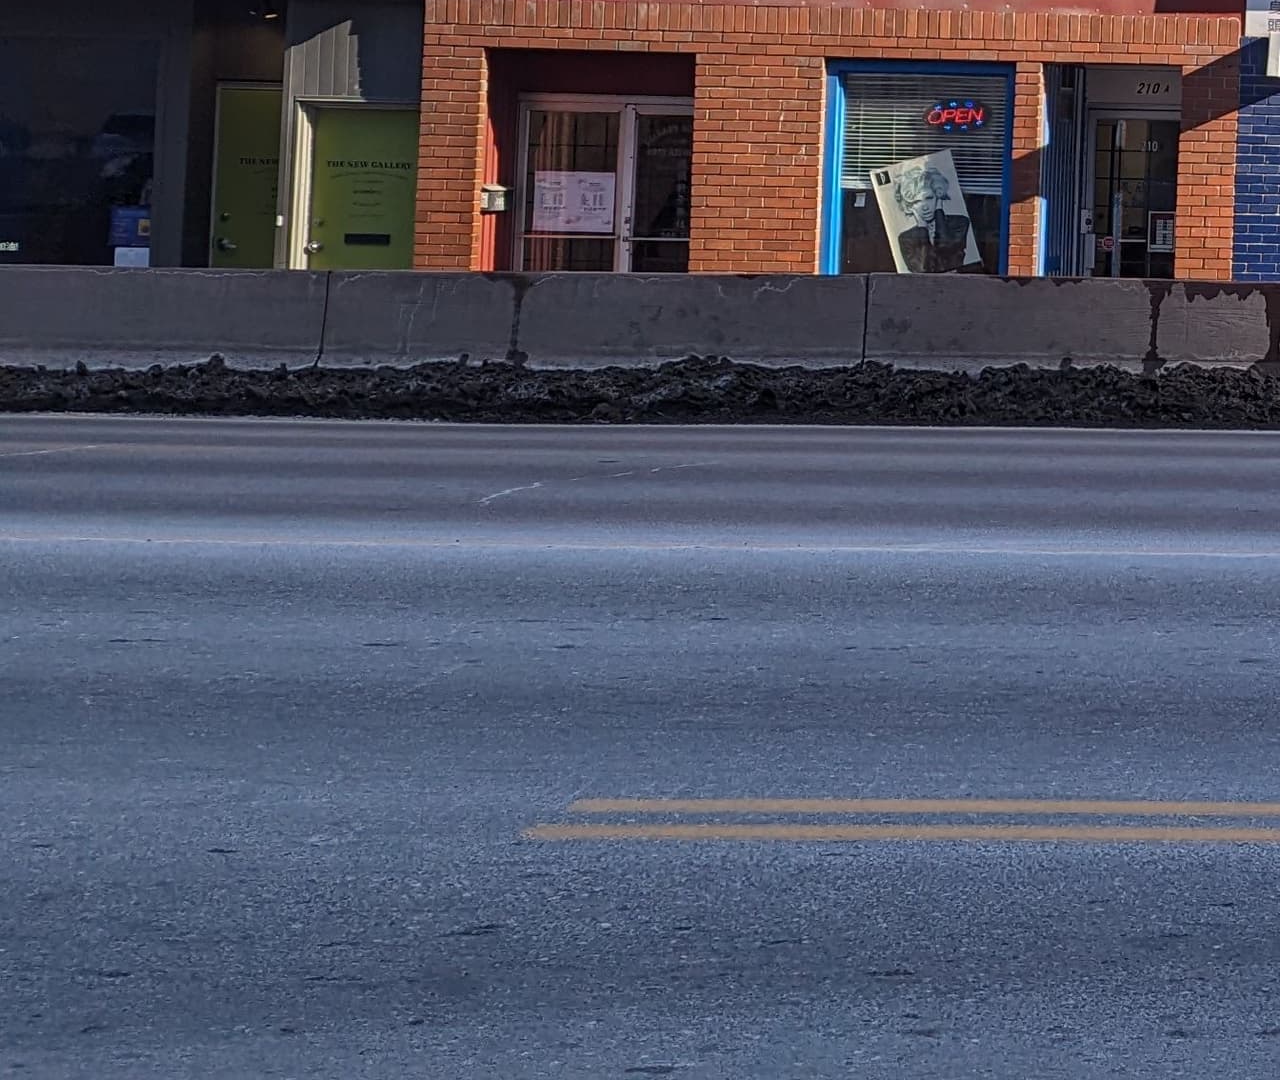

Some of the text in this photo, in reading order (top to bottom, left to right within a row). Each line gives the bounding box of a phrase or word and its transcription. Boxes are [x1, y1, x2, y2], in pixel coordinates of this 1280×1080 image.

[1137, 82, 1160, 95] 210
[927, 107, 985, 125] OPEN
[327, 160, 413, 170] THE NEW GALLERY
